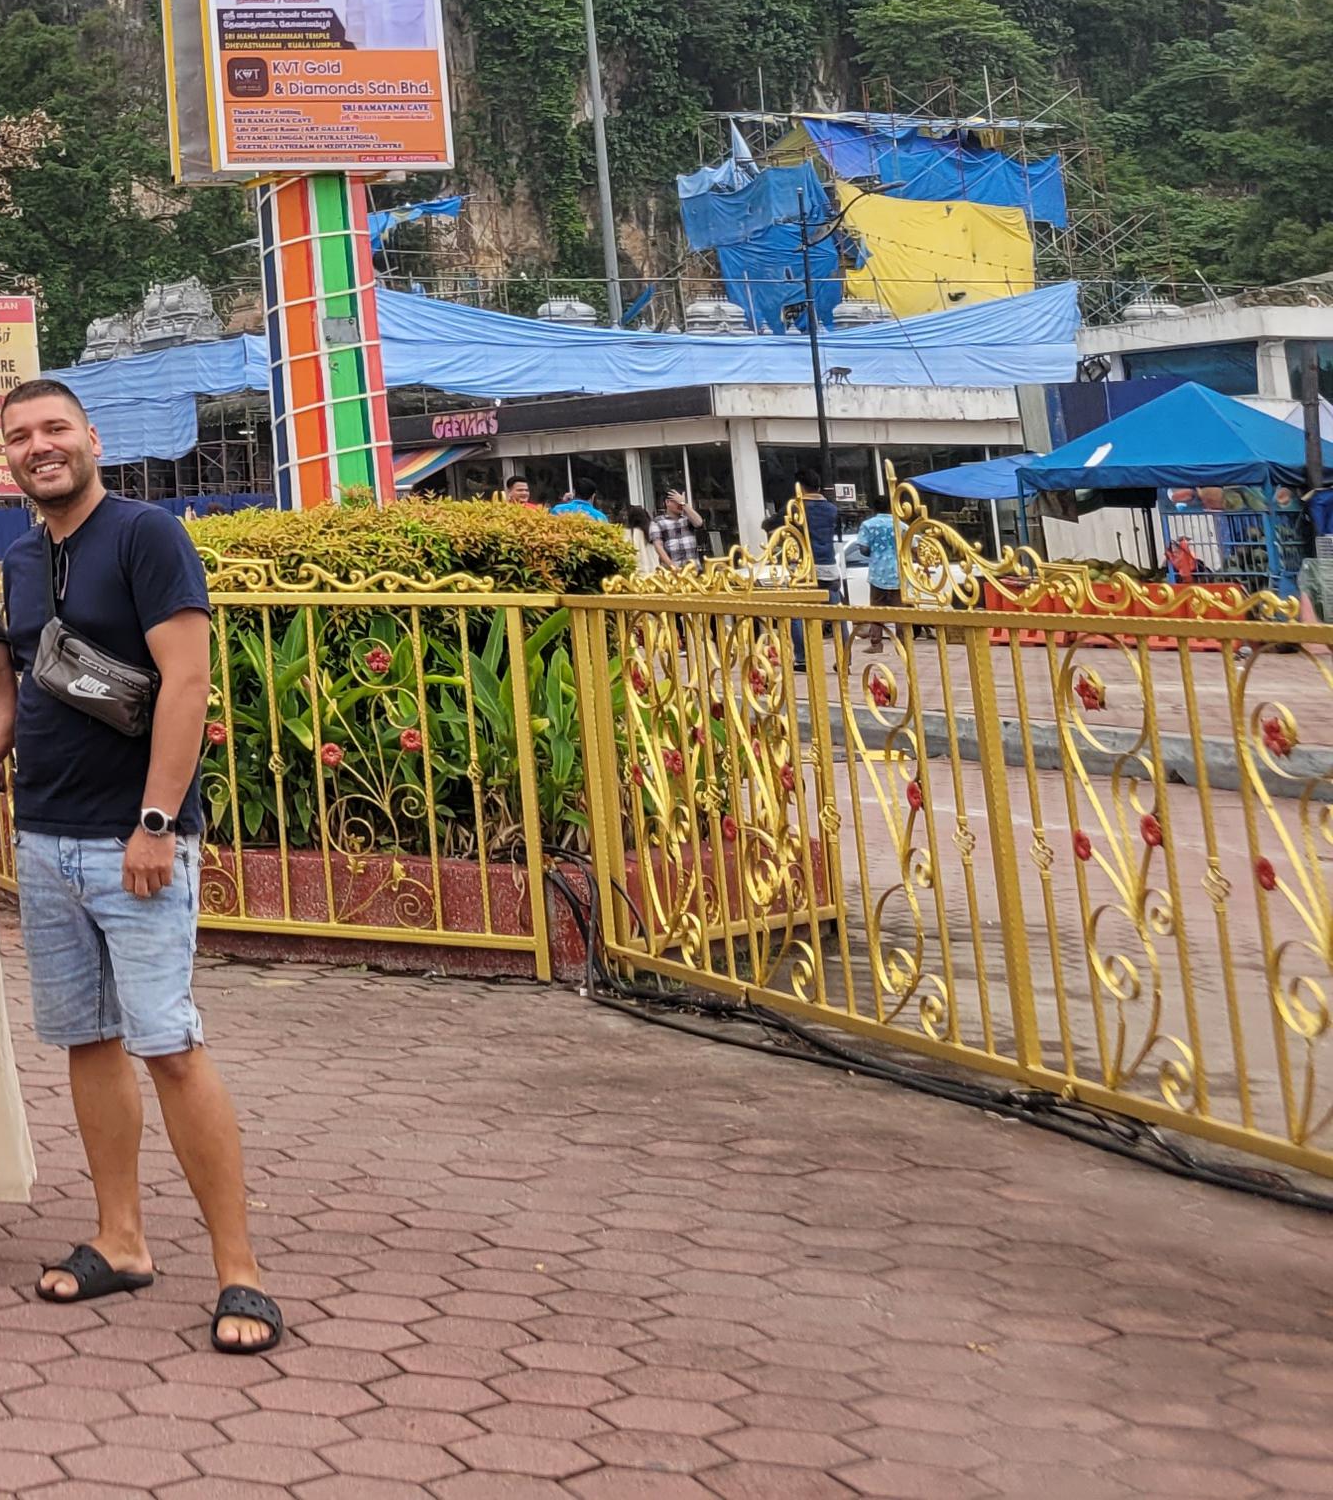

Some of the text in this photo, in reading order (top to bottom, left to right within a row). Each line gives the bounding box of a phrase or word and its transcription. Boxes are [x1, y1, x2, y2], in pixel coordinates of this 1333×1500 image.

[273, 60, 341, 74] KVT Gold
[274, 85, 284, 95] &
[289, 82, 364, 95] Diamonds
[407, 103, 429, 111] CAVE
[76, 674, 111, 695] NIKE
